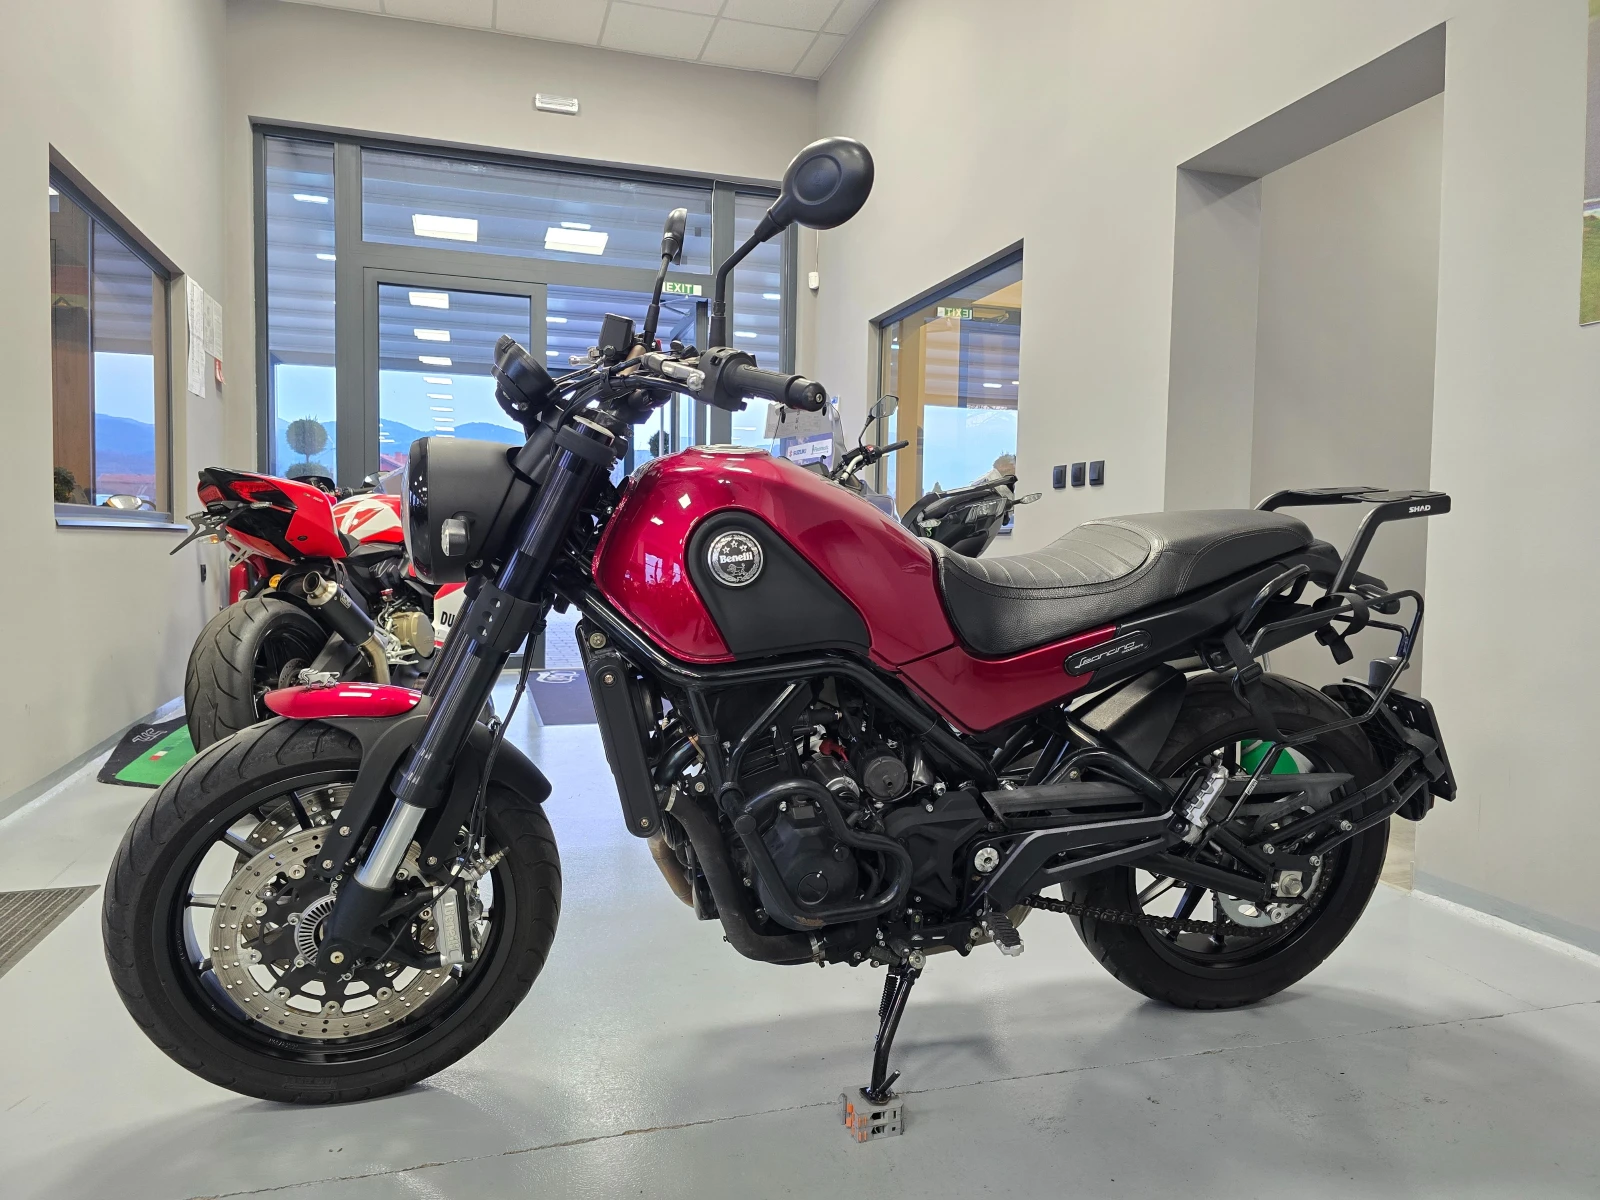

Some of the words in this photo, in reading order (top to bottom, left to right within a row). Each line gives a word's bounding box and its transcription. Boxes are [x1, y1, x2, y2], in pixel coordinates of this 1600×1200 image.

[666, 282, 693, 294] EXIT
[1408, 504, 1431, 513] SHAD
[719, 551, 753, 564] Benelli
